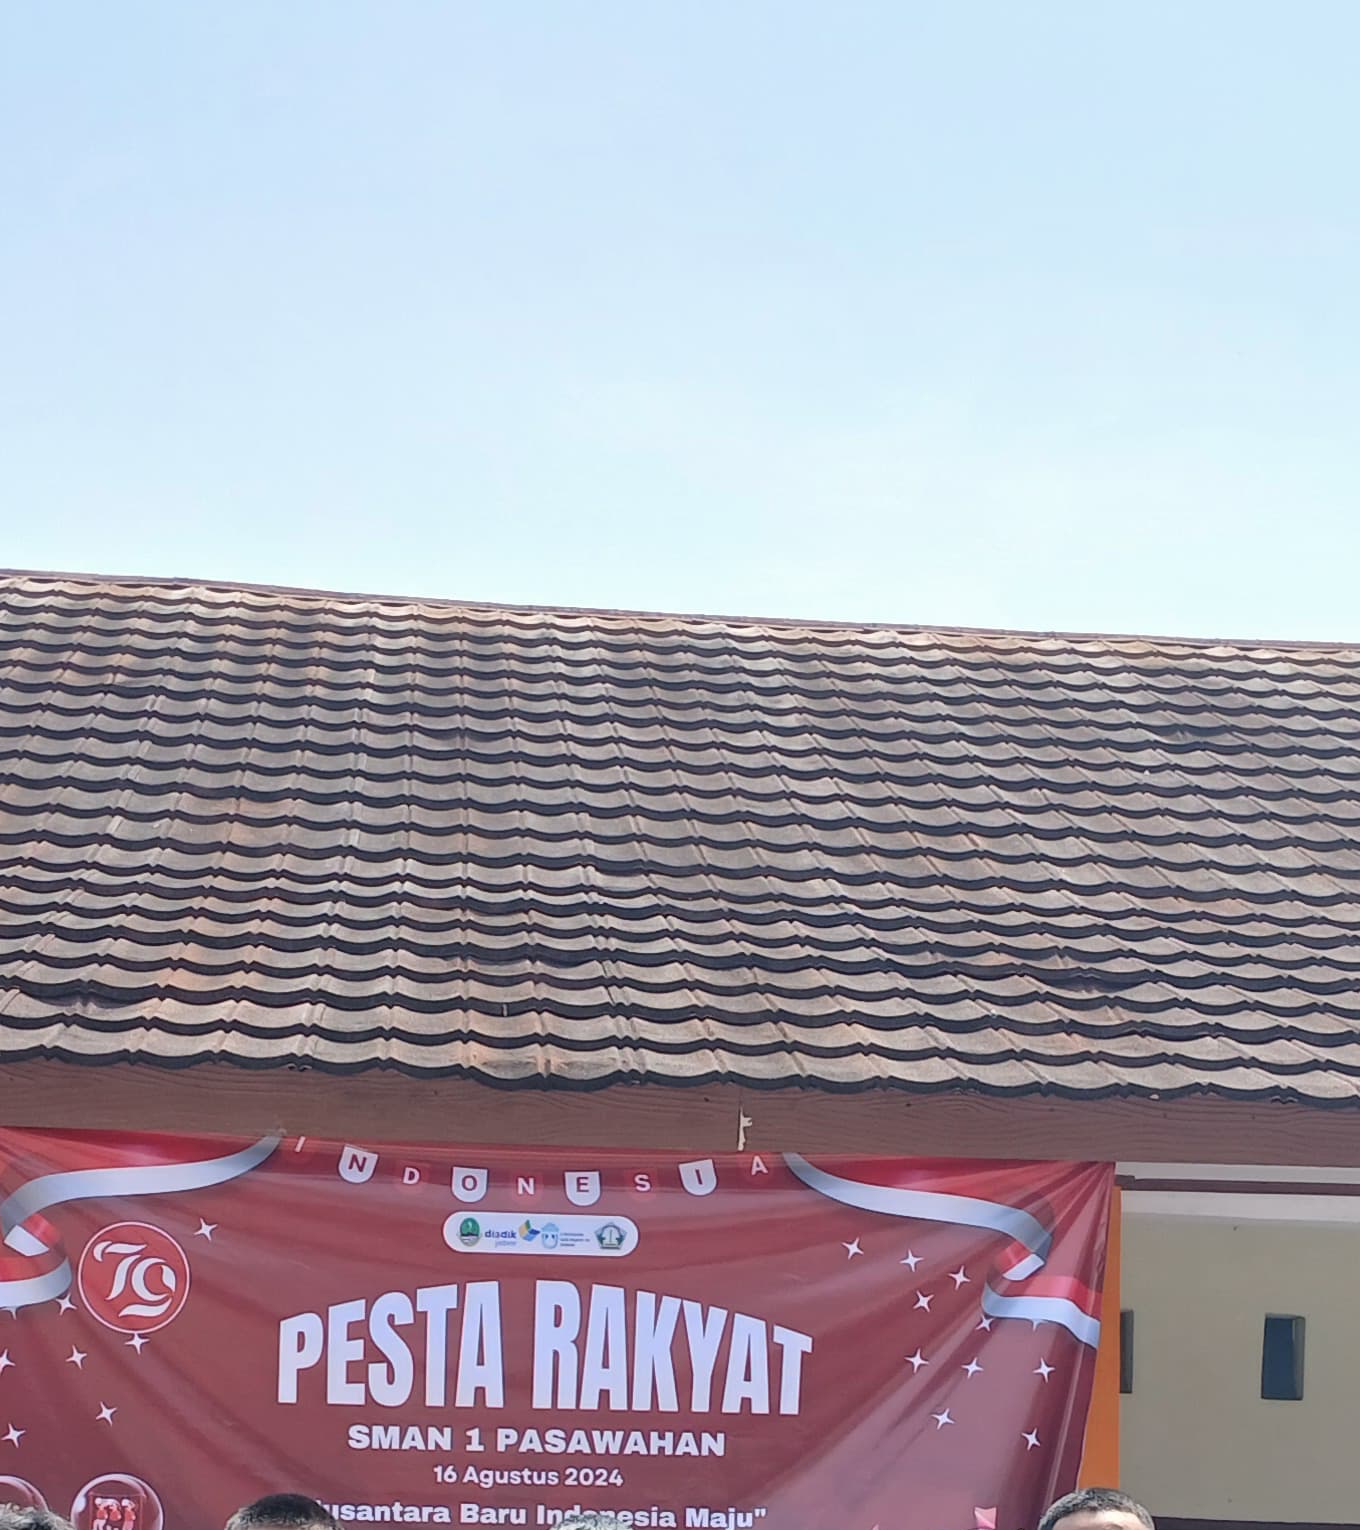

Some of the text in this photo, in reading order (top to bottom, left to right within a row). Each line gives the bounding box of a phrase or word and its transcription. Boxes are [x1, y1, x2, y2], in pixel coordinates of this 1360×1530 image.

[277, 1279, 813, 1416] PESTA RAKYAT
[347, 1424, 725, 1457] SMAN 1 PASAWAHAN
[433, 1465, 624, 1488] 16 Agustus 2024
[325, 1501, 450, 1524] usantara
[460, 1503, 526, 1525] Baru
